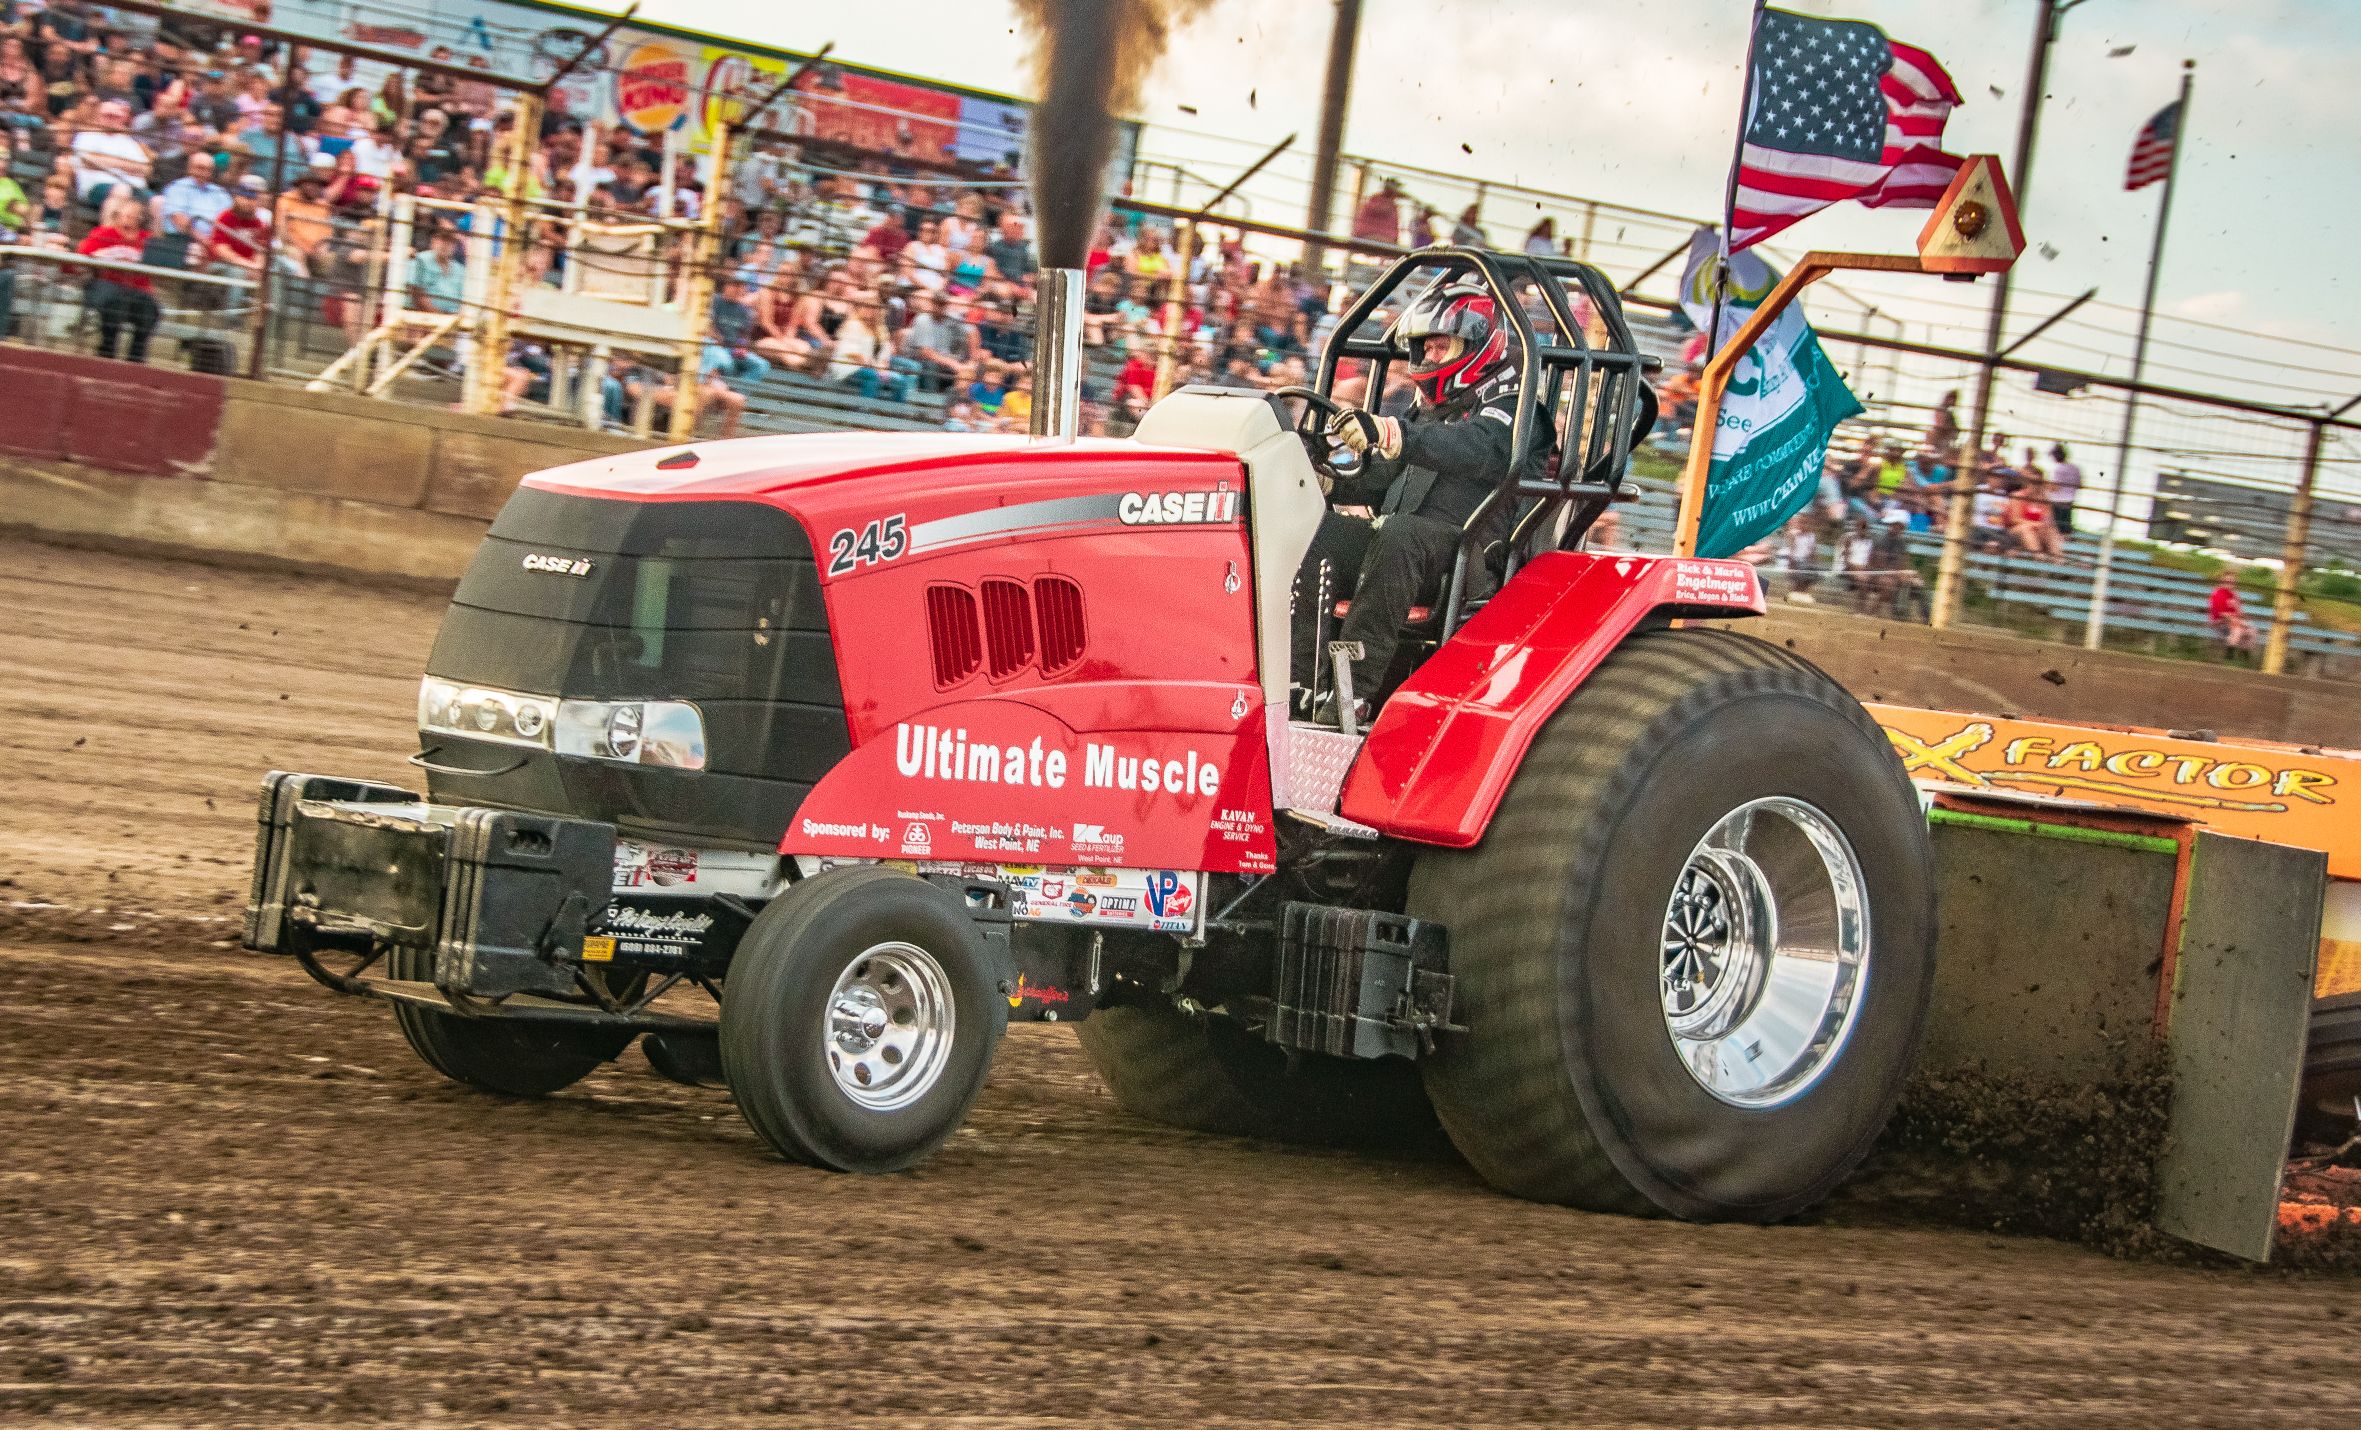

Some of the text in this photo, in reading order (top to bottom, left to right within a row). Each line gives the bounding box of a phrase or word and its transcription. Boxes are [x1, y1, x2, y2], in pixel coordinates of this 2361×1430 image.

[1118, 491, 1206, 525] CASE
[828, 512, 906, 577] 245
[522, 553, 574, 573] CASE
[1702, 565, 1713, 575] &
[1676, 573, 1747, 594] Engelmeyer
[896, 723, 1220, 796] Ultimate Muscle
[2003, 735, 2337, 805] FACTOR
[1220, 808, 1256, 823] KAVAN
[802, 818, 890, 843] Sponsored by:
[951, 820, 1065, 840] Peterson Body & Paint, Inc.
[1210, 820, 1265, 834] ENGINE & DYNO
[1223, 831, 1251, 842] SERVICE
[901, 844, 932, 856] PIONEER
[974, 835, 1041, 853] West Point, NE
[1244, 850, 1269, 860] Thanks
[1146, 870, 1178, 917] VP
[1101, 896, 1136, 911] OPTIMA
[1161, 921, 1186, 930] TITAN
